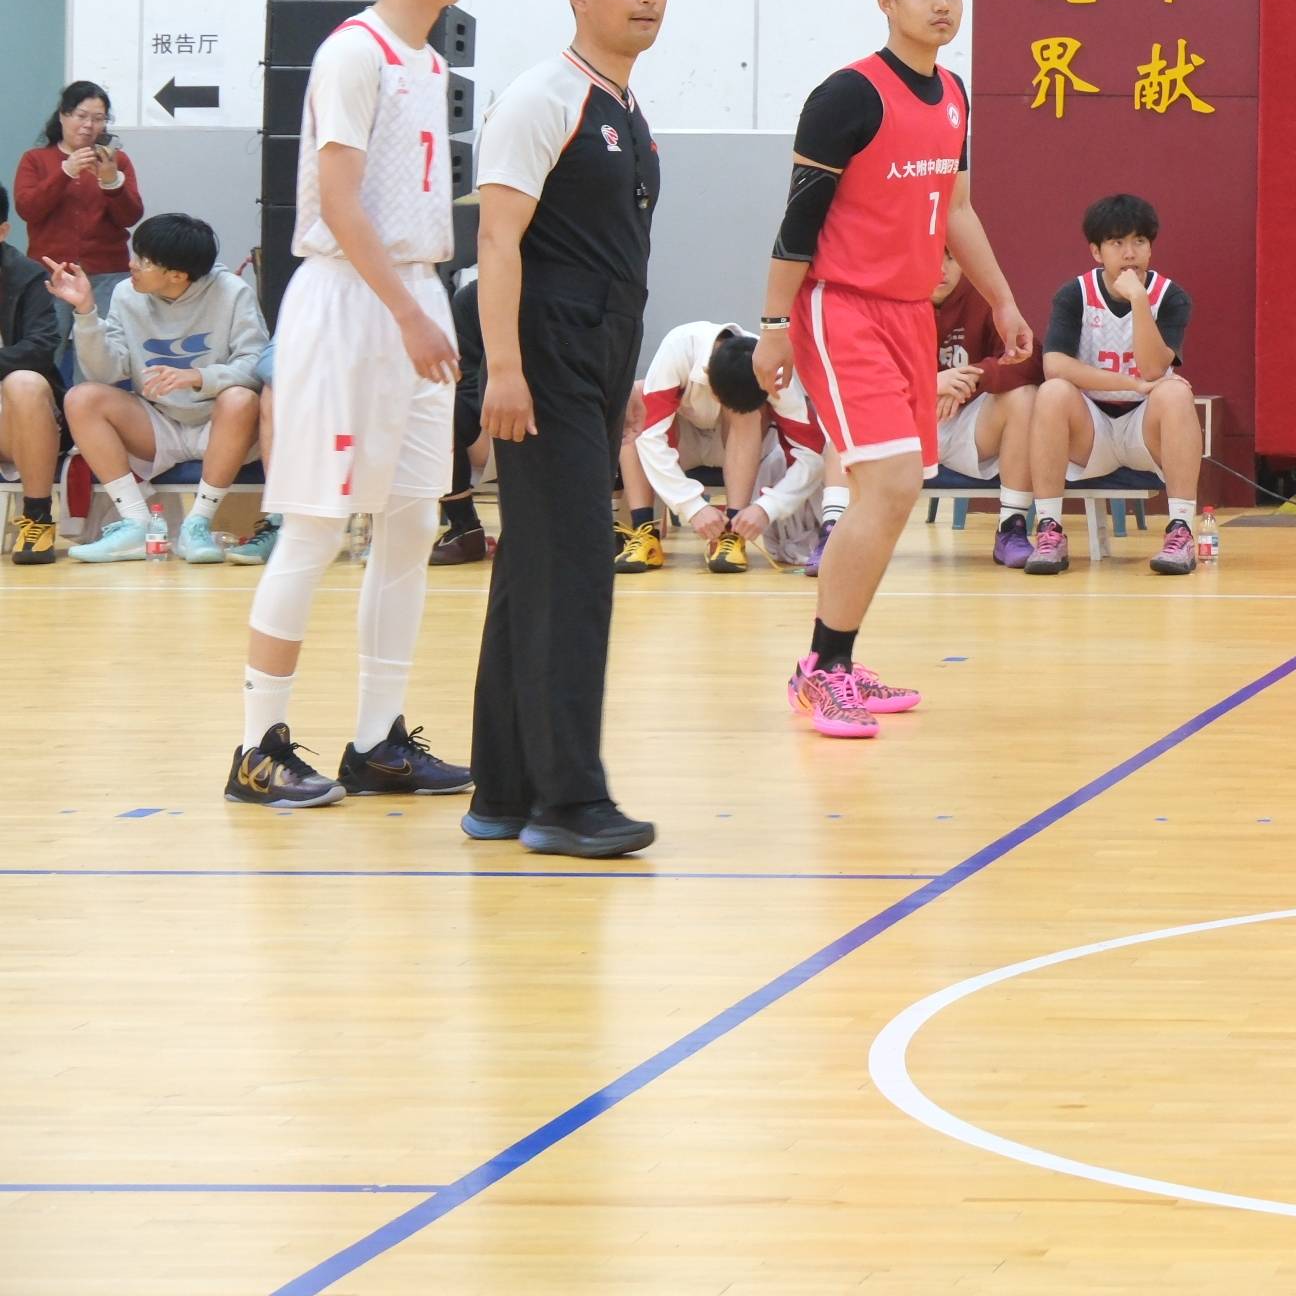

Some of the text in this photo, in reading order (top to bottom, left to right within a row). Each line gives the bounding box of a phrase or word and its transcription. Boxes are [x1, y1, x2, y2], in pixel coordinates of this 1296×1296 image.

[152, 33, 219, 54] 报告厅
[419, 130, 435, 193] 7
[929, 192, 940, 235] 7
